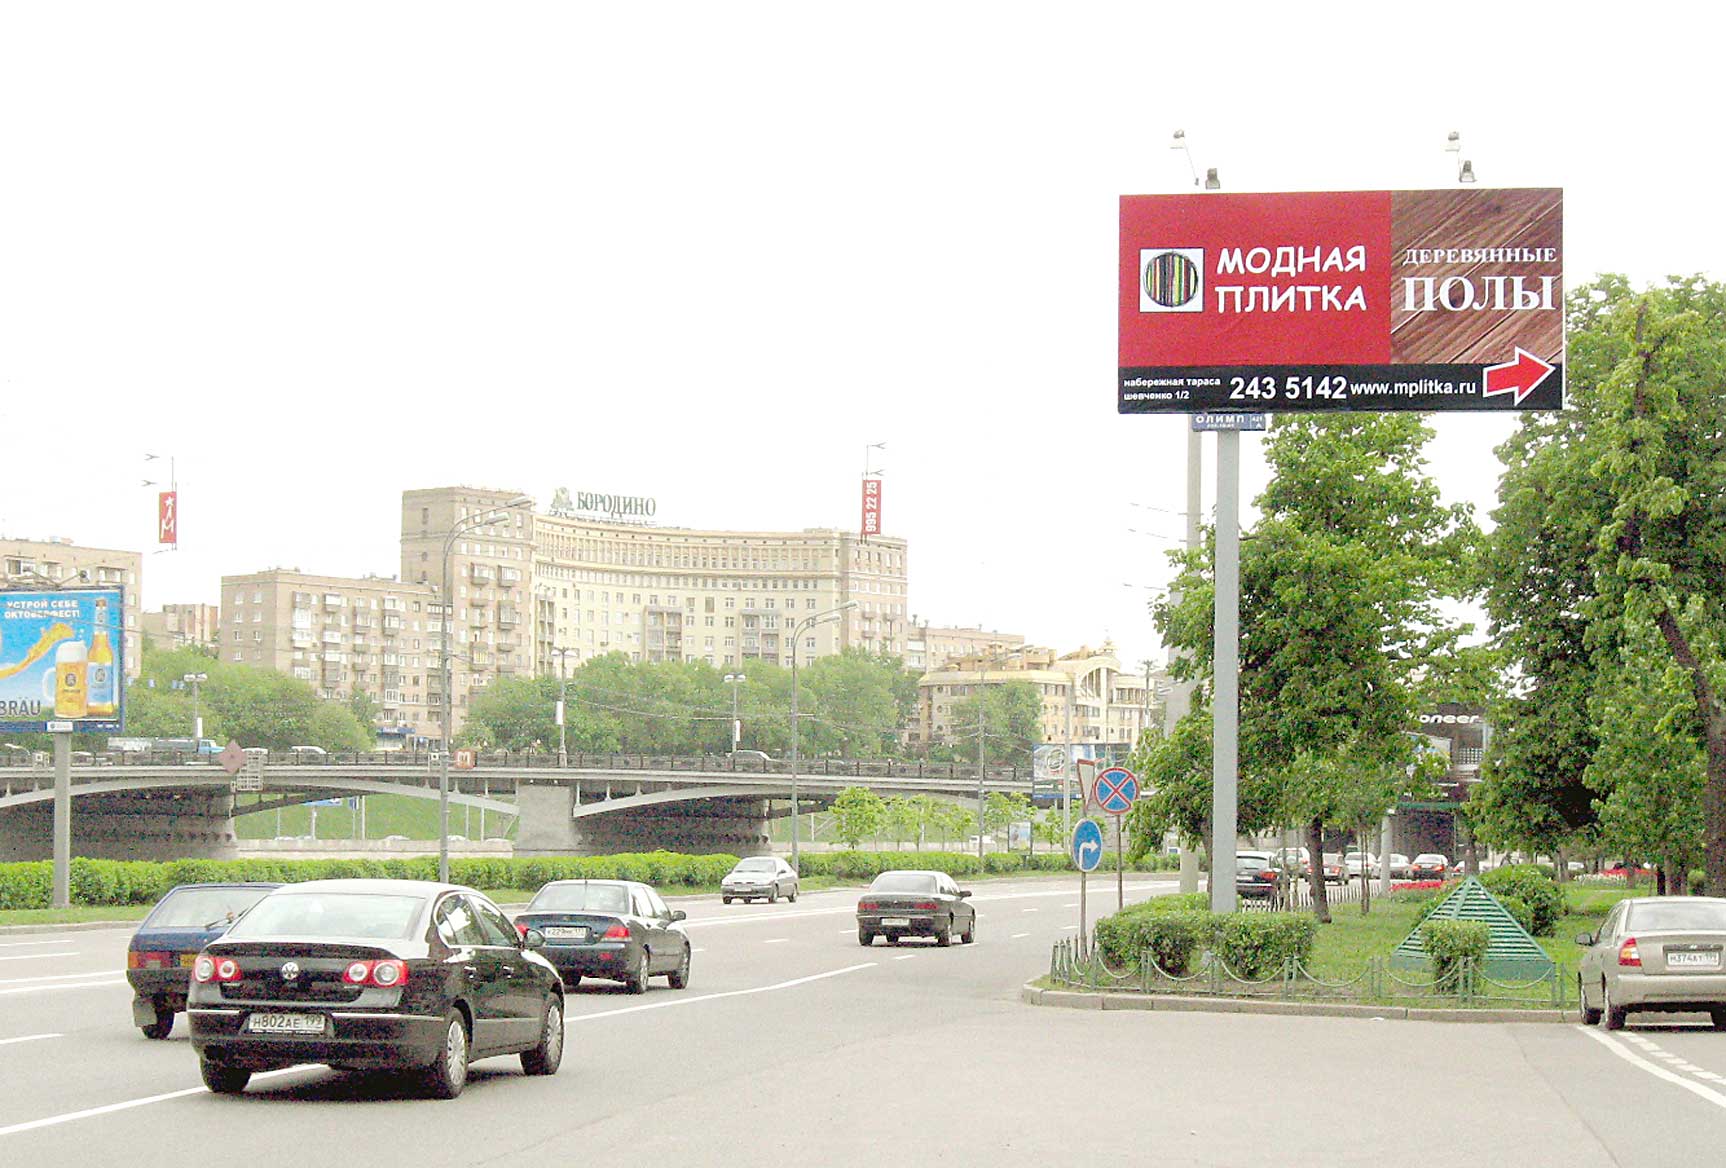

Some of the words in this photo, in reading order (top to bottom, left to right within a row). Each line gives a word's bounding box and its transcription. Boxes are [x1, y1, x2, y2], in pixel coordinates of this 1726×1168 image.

[1216, 245, 1366, 278] МОДНАЯ
[1402, 247, 1557, 267] ДЕРЕВЯННЫЕ
[1214, 285, 1367, 313] ПЛИТКА
[1401, 275, 1557, 311] ПОЛЫ
[1123, 377, 1185, 388] набережная
[1186, 378, 1221, 388] тараса
[1229, 376, 1277, 400] 243
[1285, 376, 1347, 400] 5142
[1350, 379, 1476, 398] www.mplitka.ru
[1123, 392, 1173, 400] шевченко
[1175, 390, 1190, 400] 1/2
[577, 491, 656, 519] БОРОДИНО
[7, 599, 48, 609] УСТРОЙ
[51, 600, 78, 608] СЕБЕ
[1419, 714, 1480, 724] oneer
